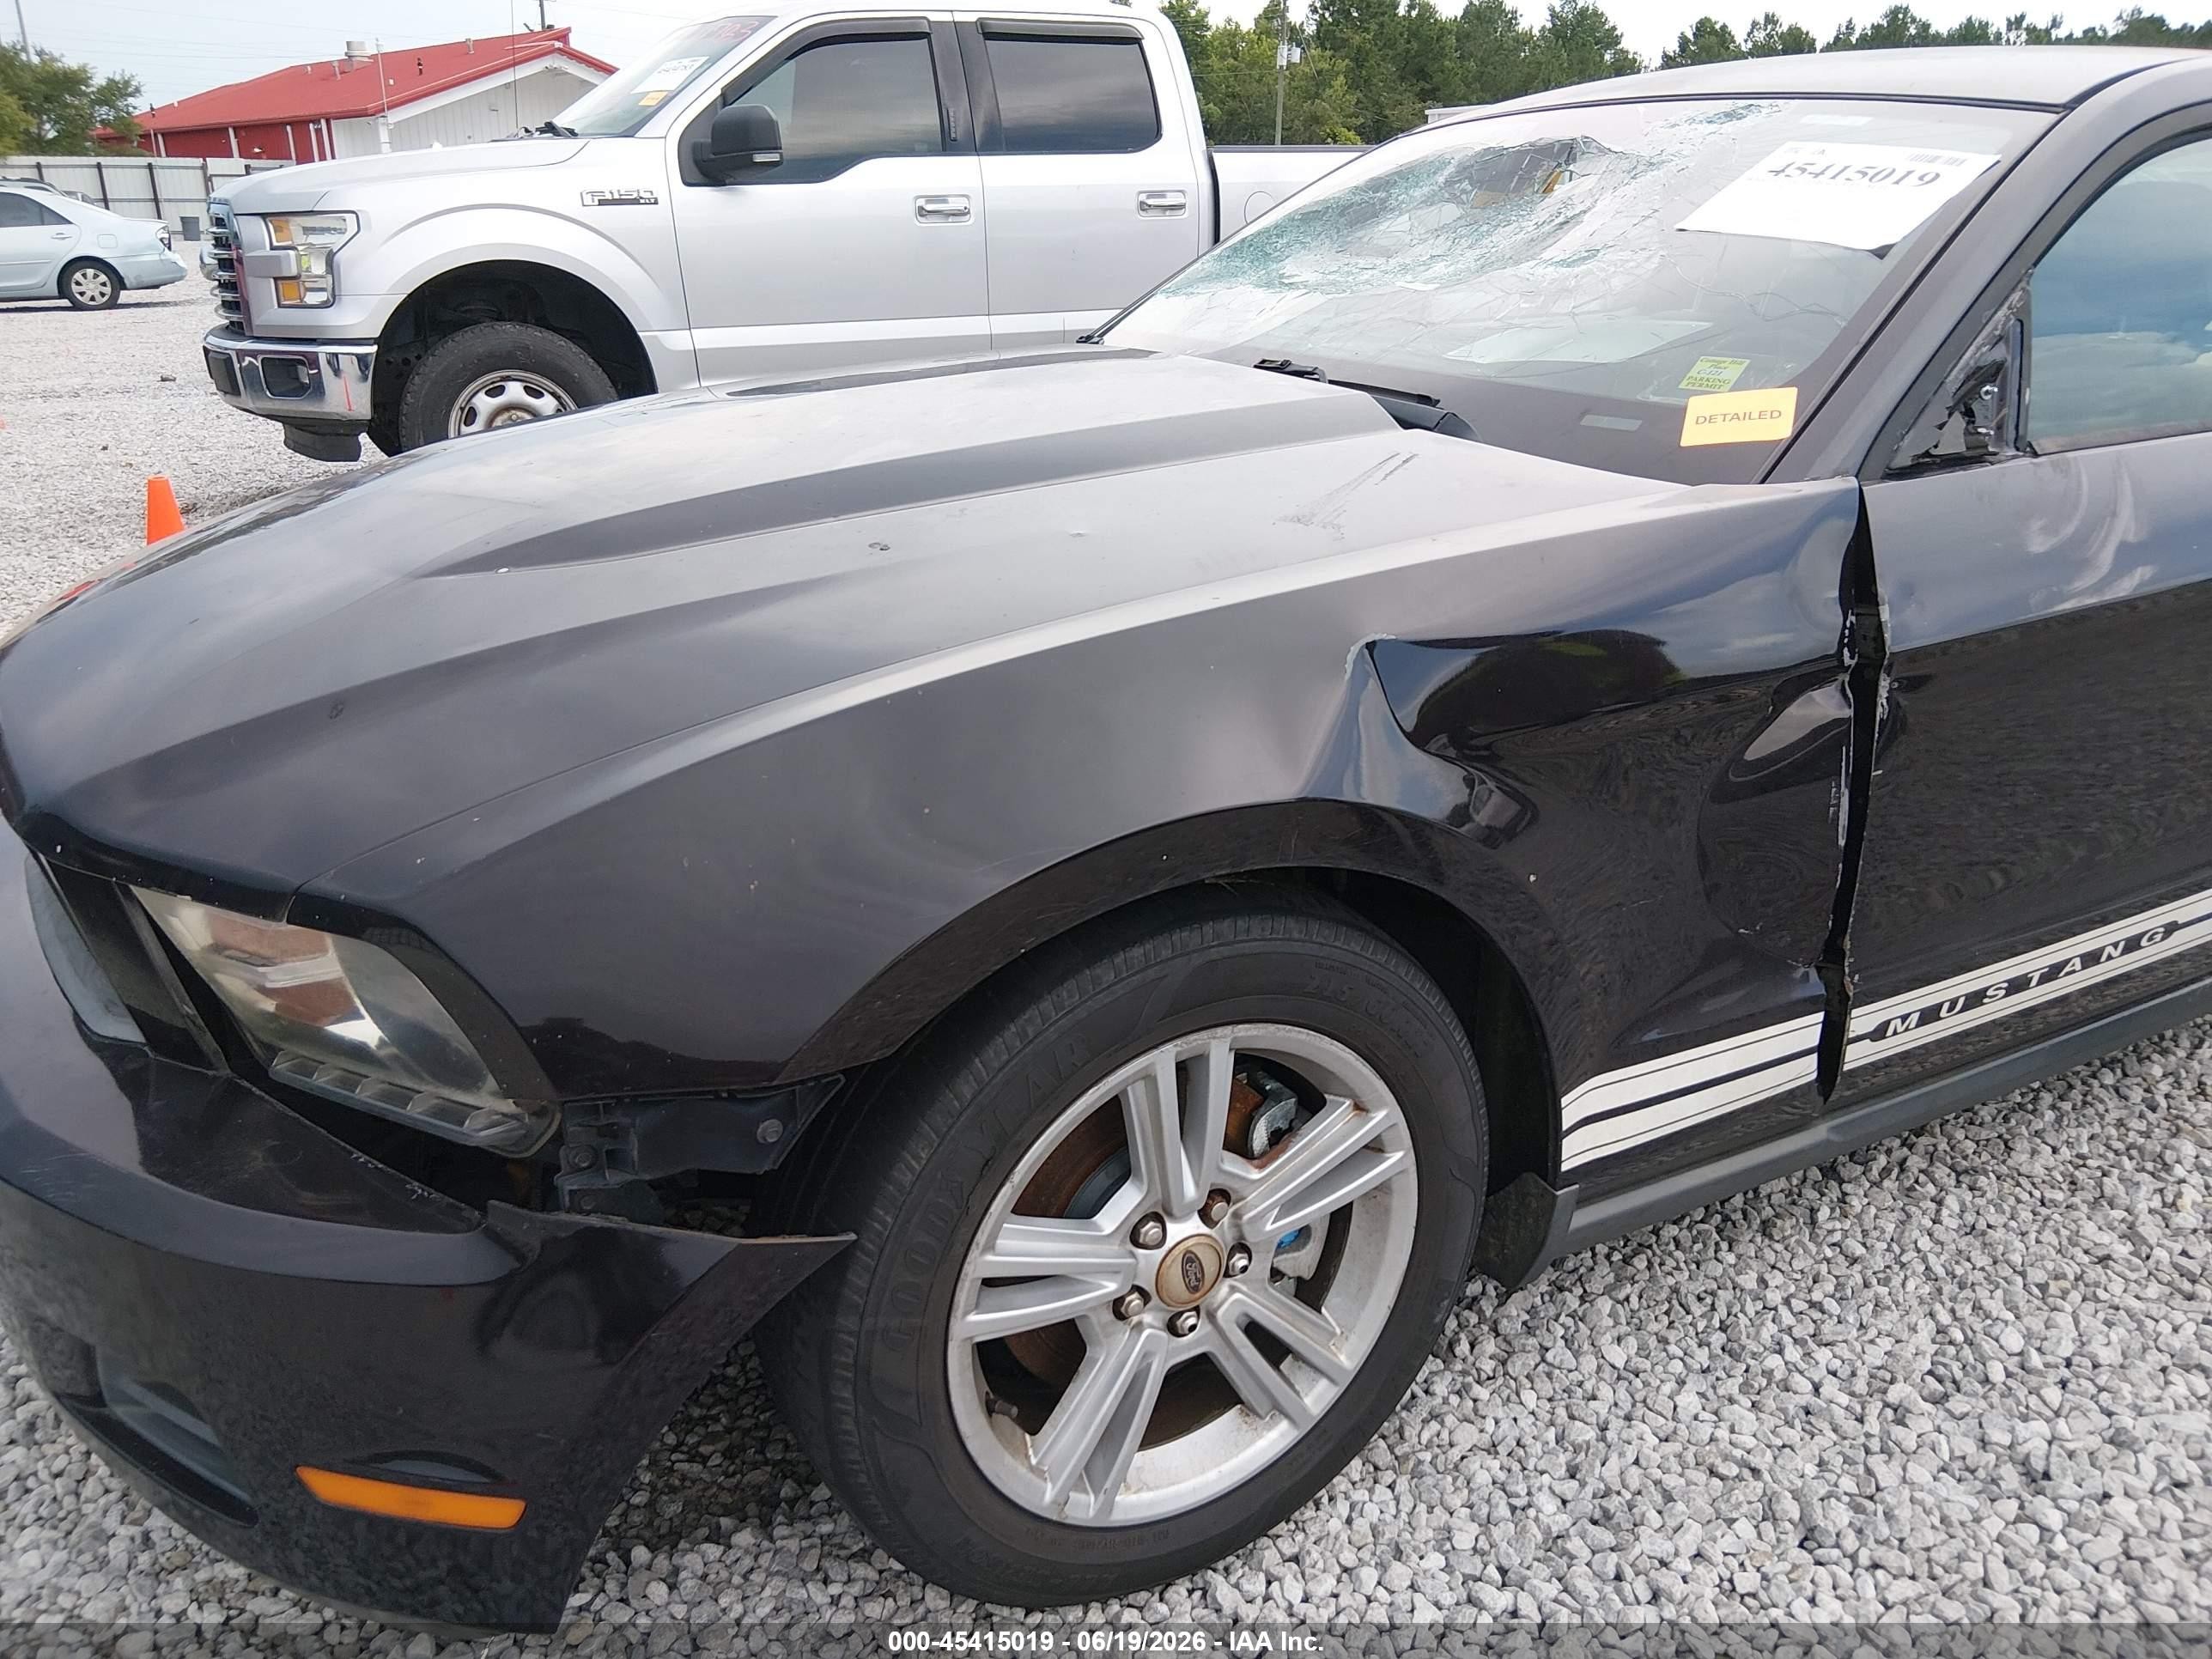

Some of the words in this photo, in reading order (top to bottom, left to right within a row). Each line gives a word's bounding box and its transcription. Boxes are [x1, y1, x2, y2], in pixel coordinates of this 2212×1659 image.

[1767, 161, 1942, 187] 45415019
[1685, 381, 1724, 390] PERMIT
[1686, 375, 1732, 385] PARKING
[1694, 410, 1783, 425] DETAILED
[1884, 927, 2166, 1037] MUSTANG
